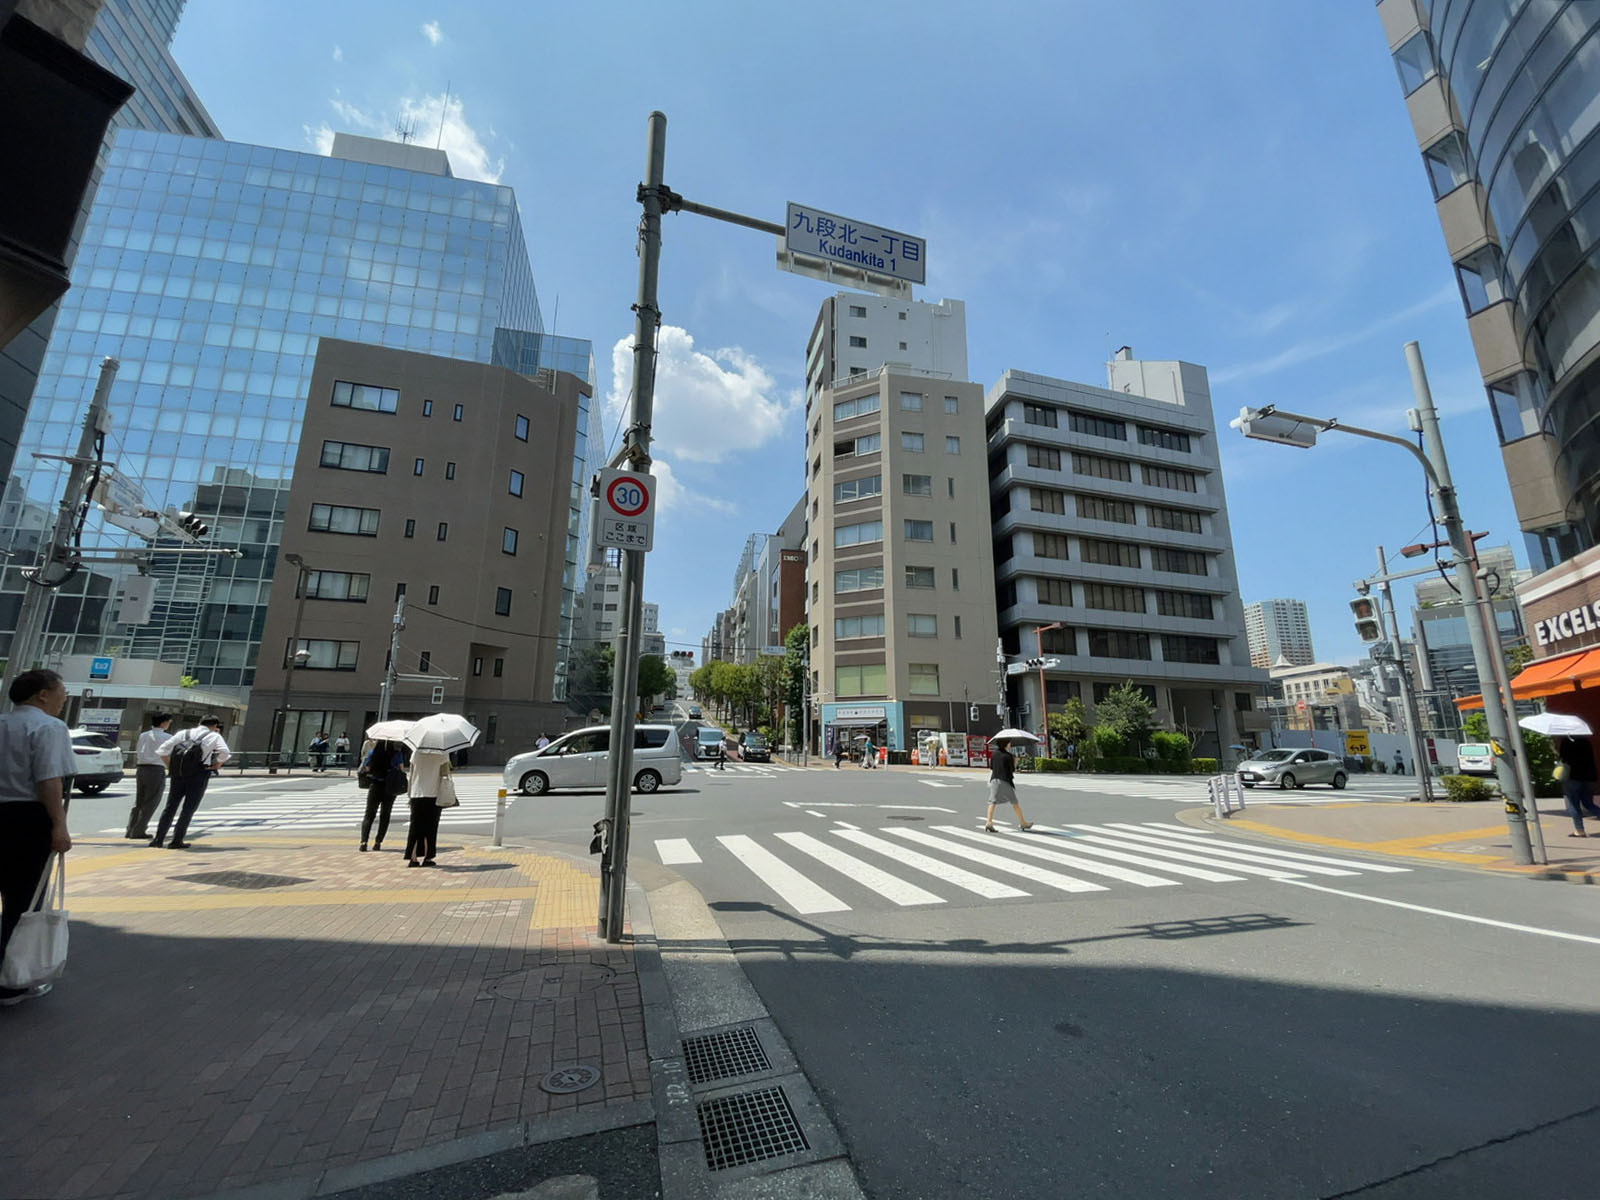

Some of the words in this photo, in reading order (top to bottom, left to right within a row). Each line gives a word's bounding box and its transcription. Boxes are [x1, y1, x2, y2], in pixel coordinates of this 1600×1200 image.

[792, 211, 920, 262] 九段北一丁目
[818, 238, 885, 269] Kudankita
[890, 258, 897, 272] 1
[616, 487, 640, 506] 30
[605, 531, 646, 545] ここまで
